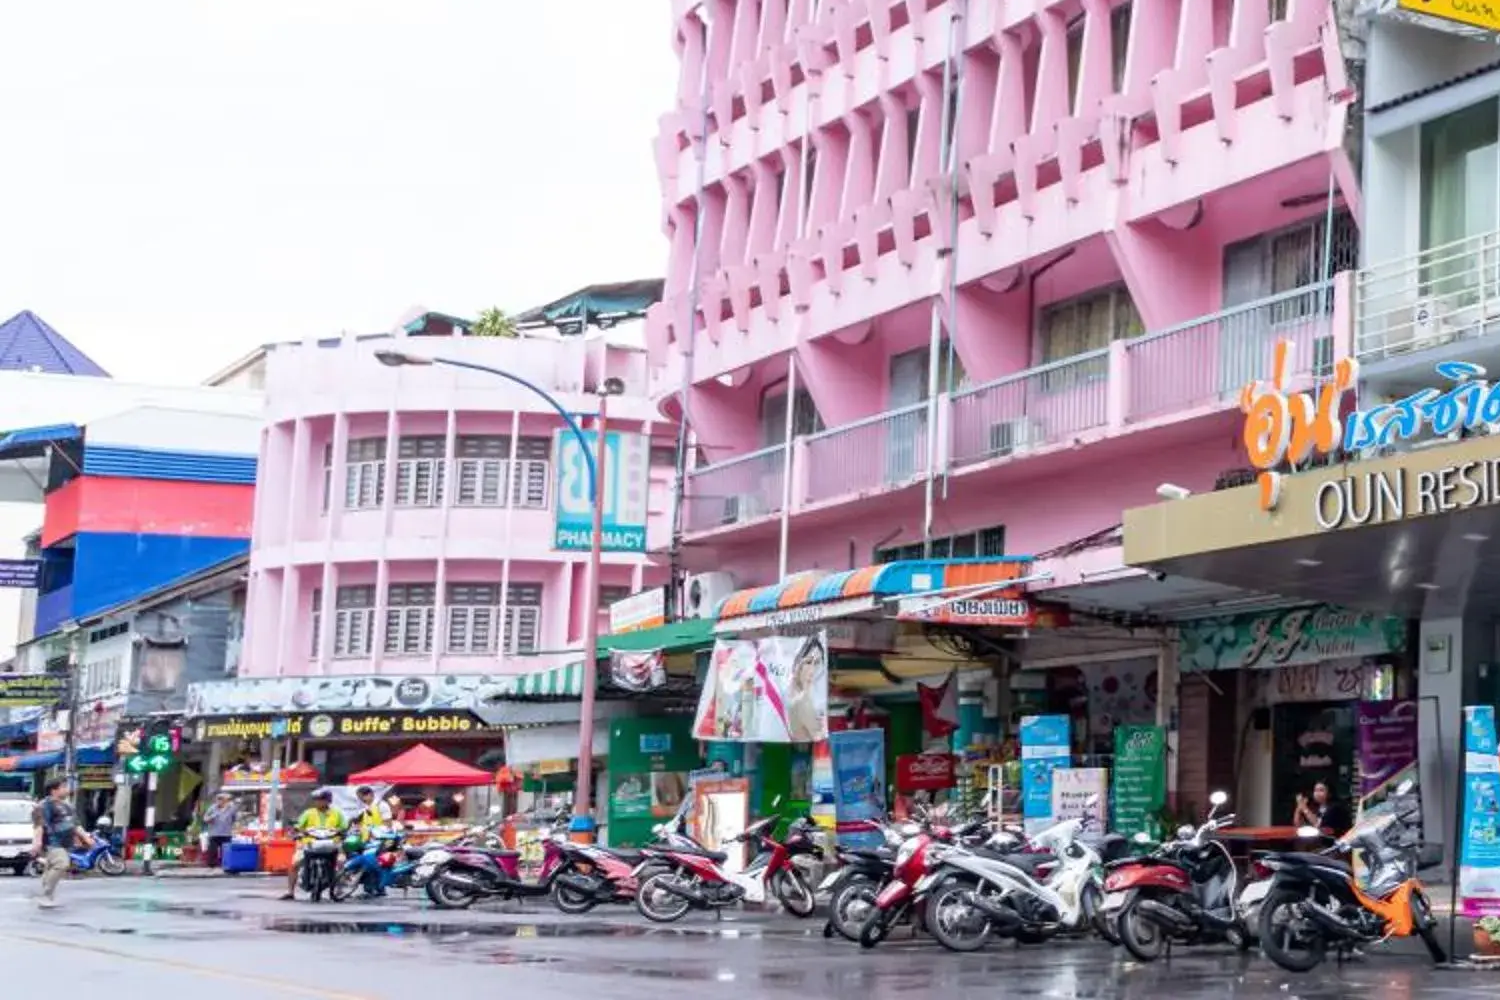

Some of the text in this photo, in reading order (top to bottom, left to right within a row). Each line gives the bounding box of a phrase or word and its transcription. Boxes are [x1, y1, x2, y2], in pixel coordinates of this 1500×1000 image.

[1241, 337, 1359, 512] อุ่น
[1314, 468, 1408, 530] OUN
[557, 528, 644, 549] PHAMACY
[402, 715, 470, 732] Bubble
